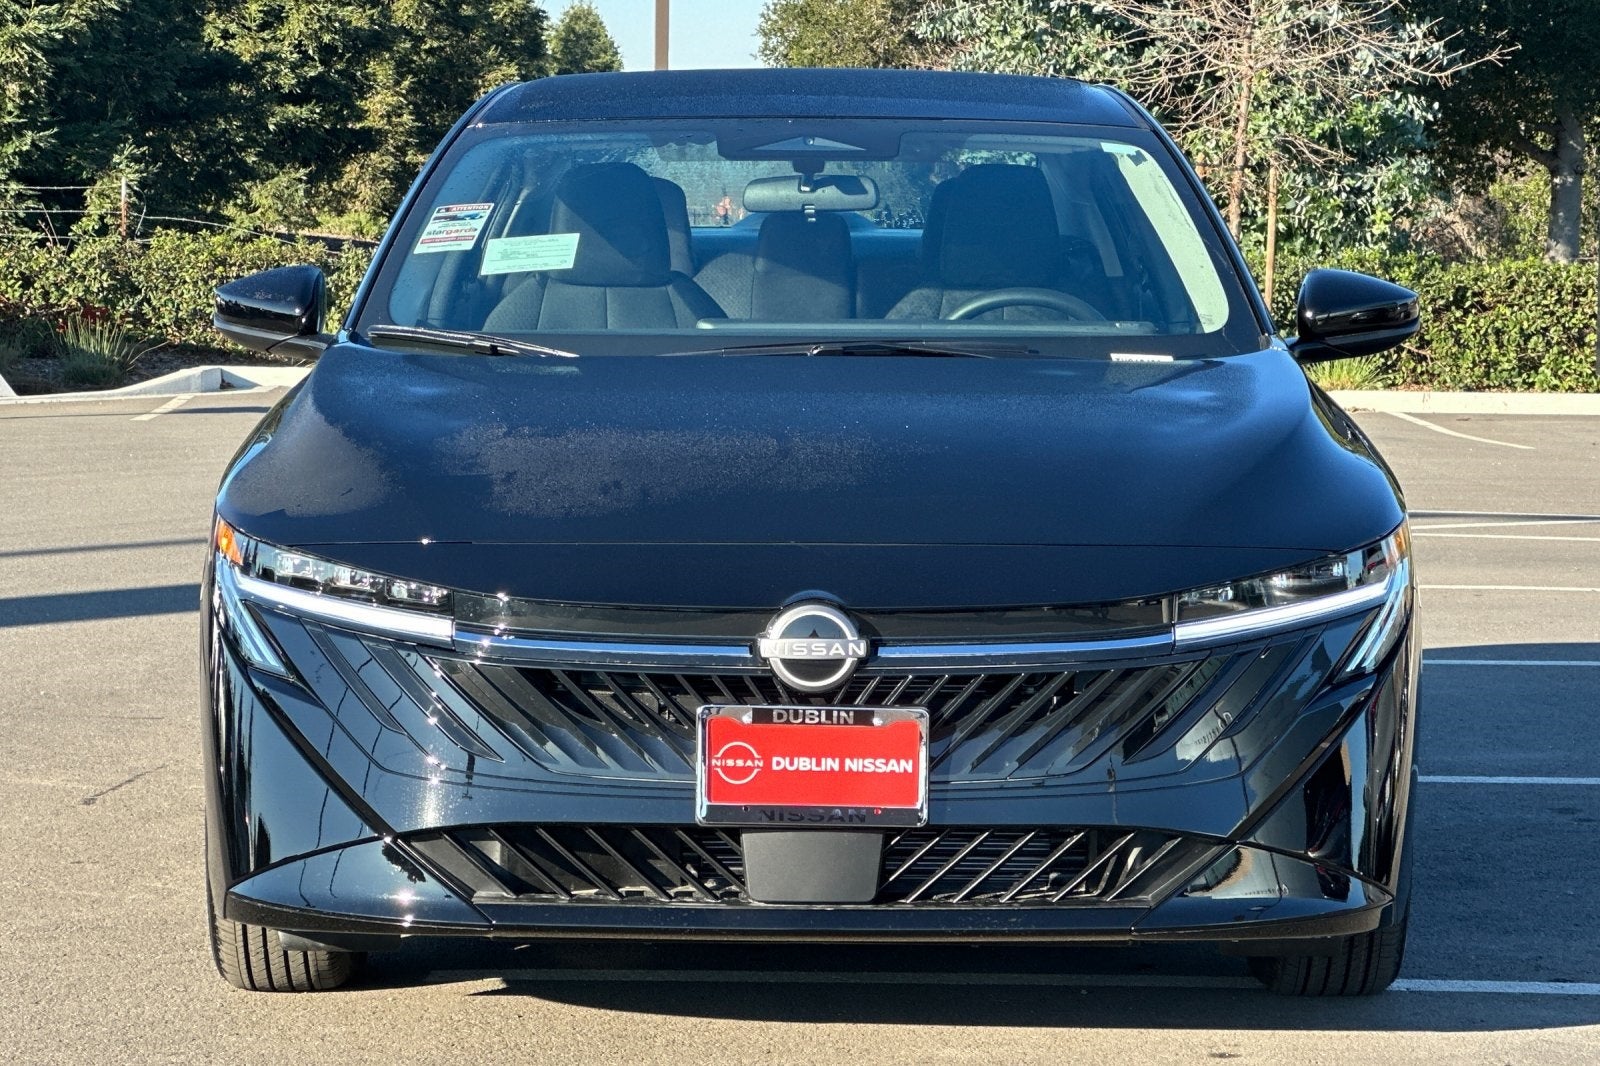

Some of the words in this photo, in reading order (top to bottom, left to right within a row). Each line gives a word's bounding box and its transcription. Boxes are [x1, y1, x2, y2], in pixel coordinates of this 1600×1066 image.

[764, 642, 866, 657] NISSAN
[772, 709, 855, 725] DUBLIN
[712, 758, 764, 767] NISSAN
[771, 757, 839, 772] DUBLIN
[845, 758, 913, 773] NISSAN
[757, 807, 867, 823] NISSAN
